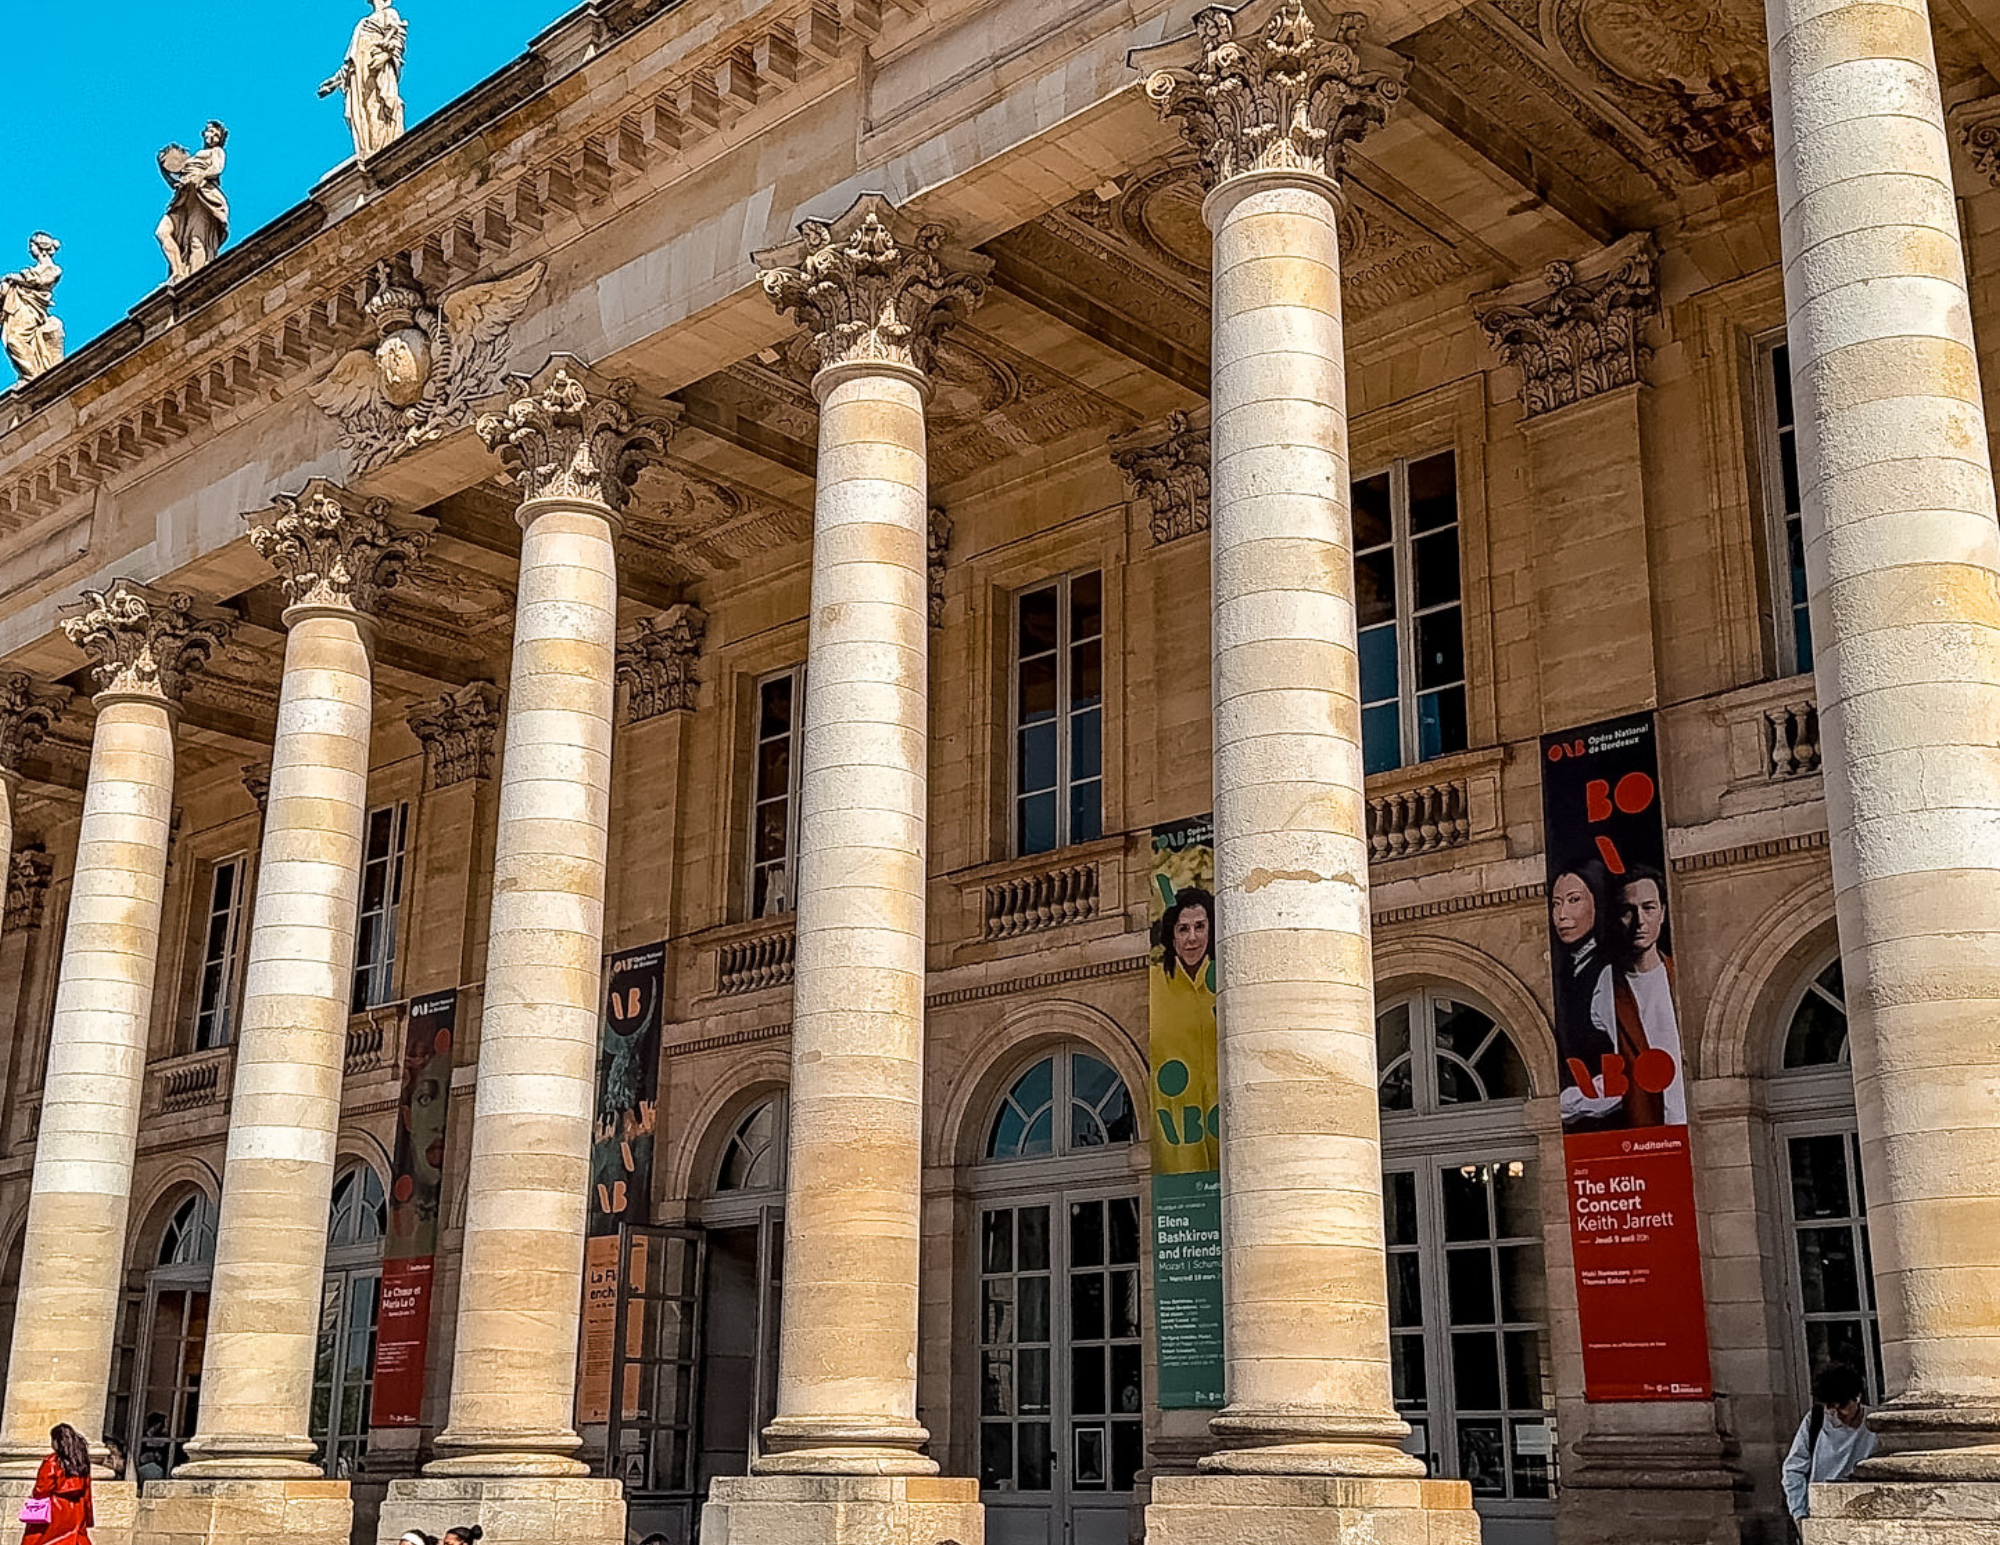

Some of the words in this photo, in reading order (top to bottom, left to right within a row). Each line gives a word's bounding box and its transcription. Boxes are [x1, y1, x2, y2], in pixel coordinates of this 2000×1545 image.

[1614, 723, 1649, 739] National
[1633, 1139, 1682, 1151] Auditorium
[1574, 1180, 1605, 1195] The
[1609, 1175, 1646, 1193] Köln
[1576, 1196, 1642, 1213] Concert
[1157, 1216, 1189, 1228] Elena
[1577, 1214, 1618, 1232] Keith
[1622, 1212, 1674, 1229] Jarrett
[1158, 1229, 1219, 1243] Bashkirova
[1158, 1246, 1180, 1259] and
[1182, 1244, 1222, 1257] friends
[591, 1270, 602, 1283] La
